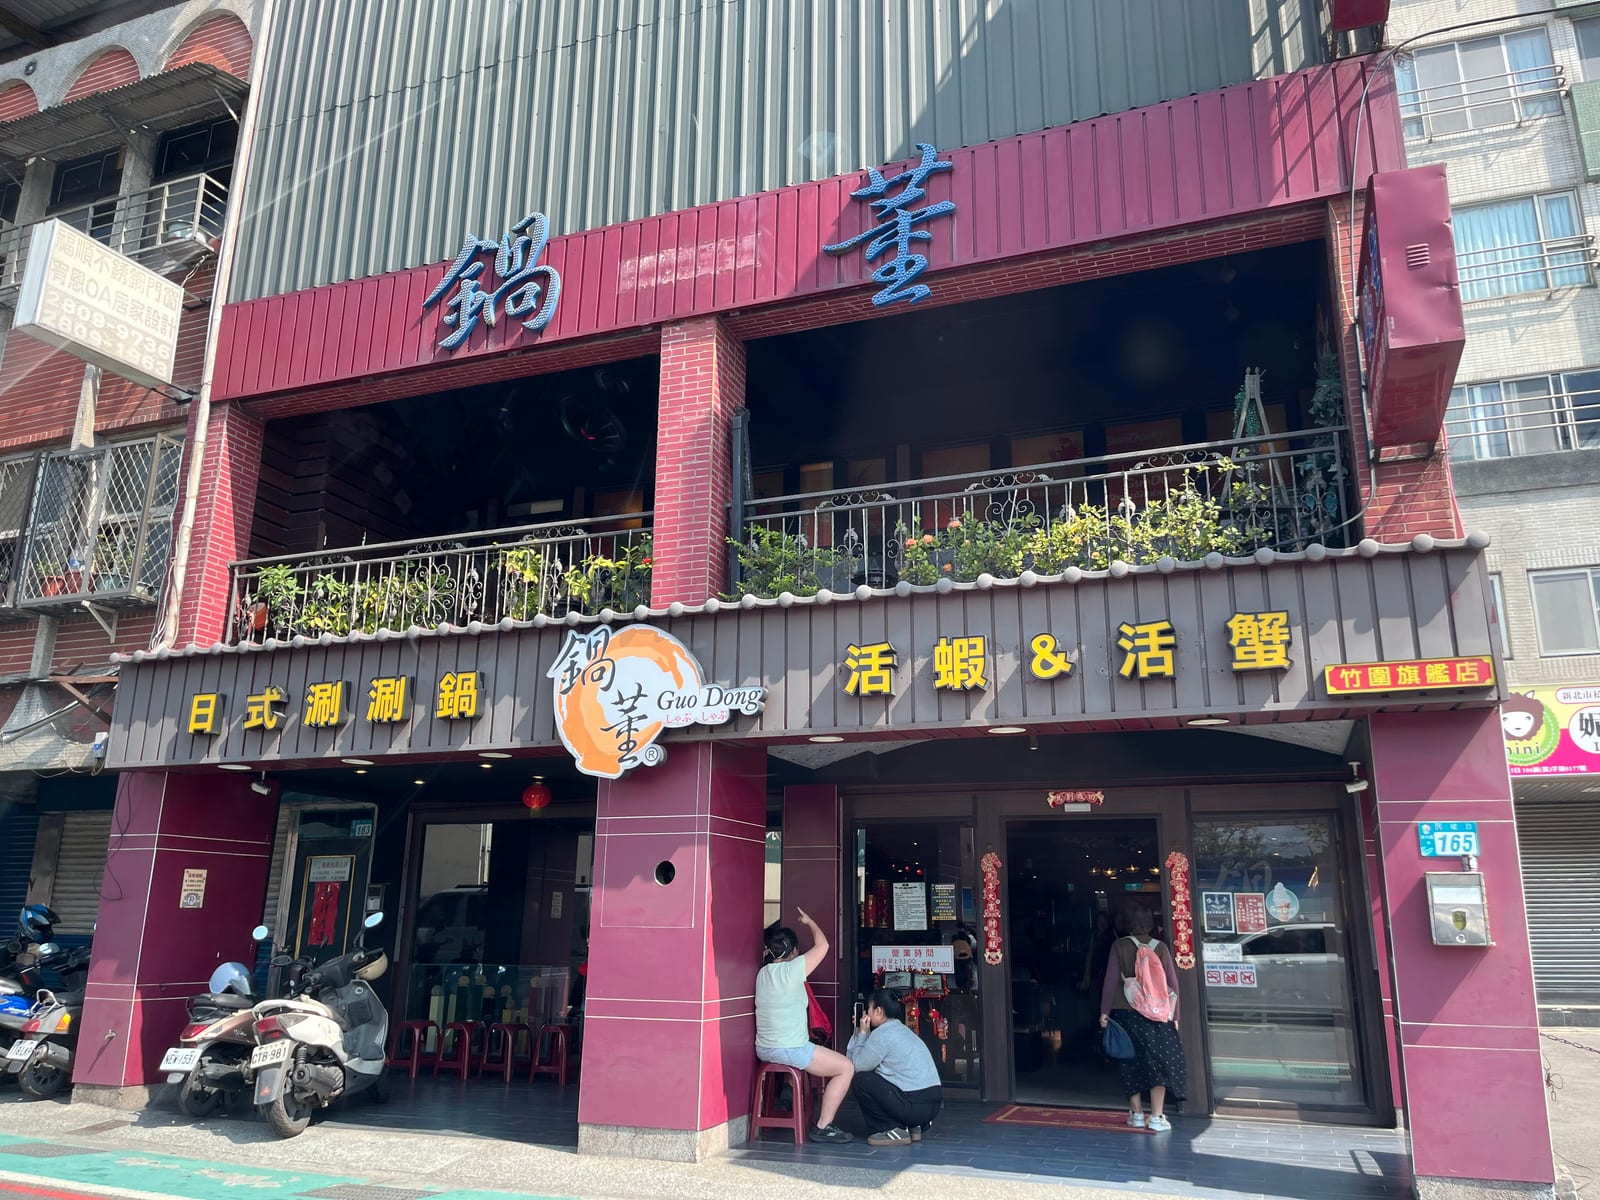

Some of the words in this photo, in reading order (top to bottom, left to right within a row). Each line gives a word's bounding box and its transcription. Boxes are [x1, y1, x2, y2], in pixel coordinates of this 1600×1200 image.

[423, 211, 560, 350] 鍋
[46, 291, 171, 360] 2809-9736
[1340, 662, 1479, 687] 竹圍旗艦店
[188, 671, 482, 735] 日式涮涮鍋
[657, 691, 697, 710] Guo
[704, 687, 761, 711] Dong
[1438, 834, 1473, 852] 165
[891, 948, 935, 957] 營業時間
[252, 1047, 287, 1064] CTB-981
